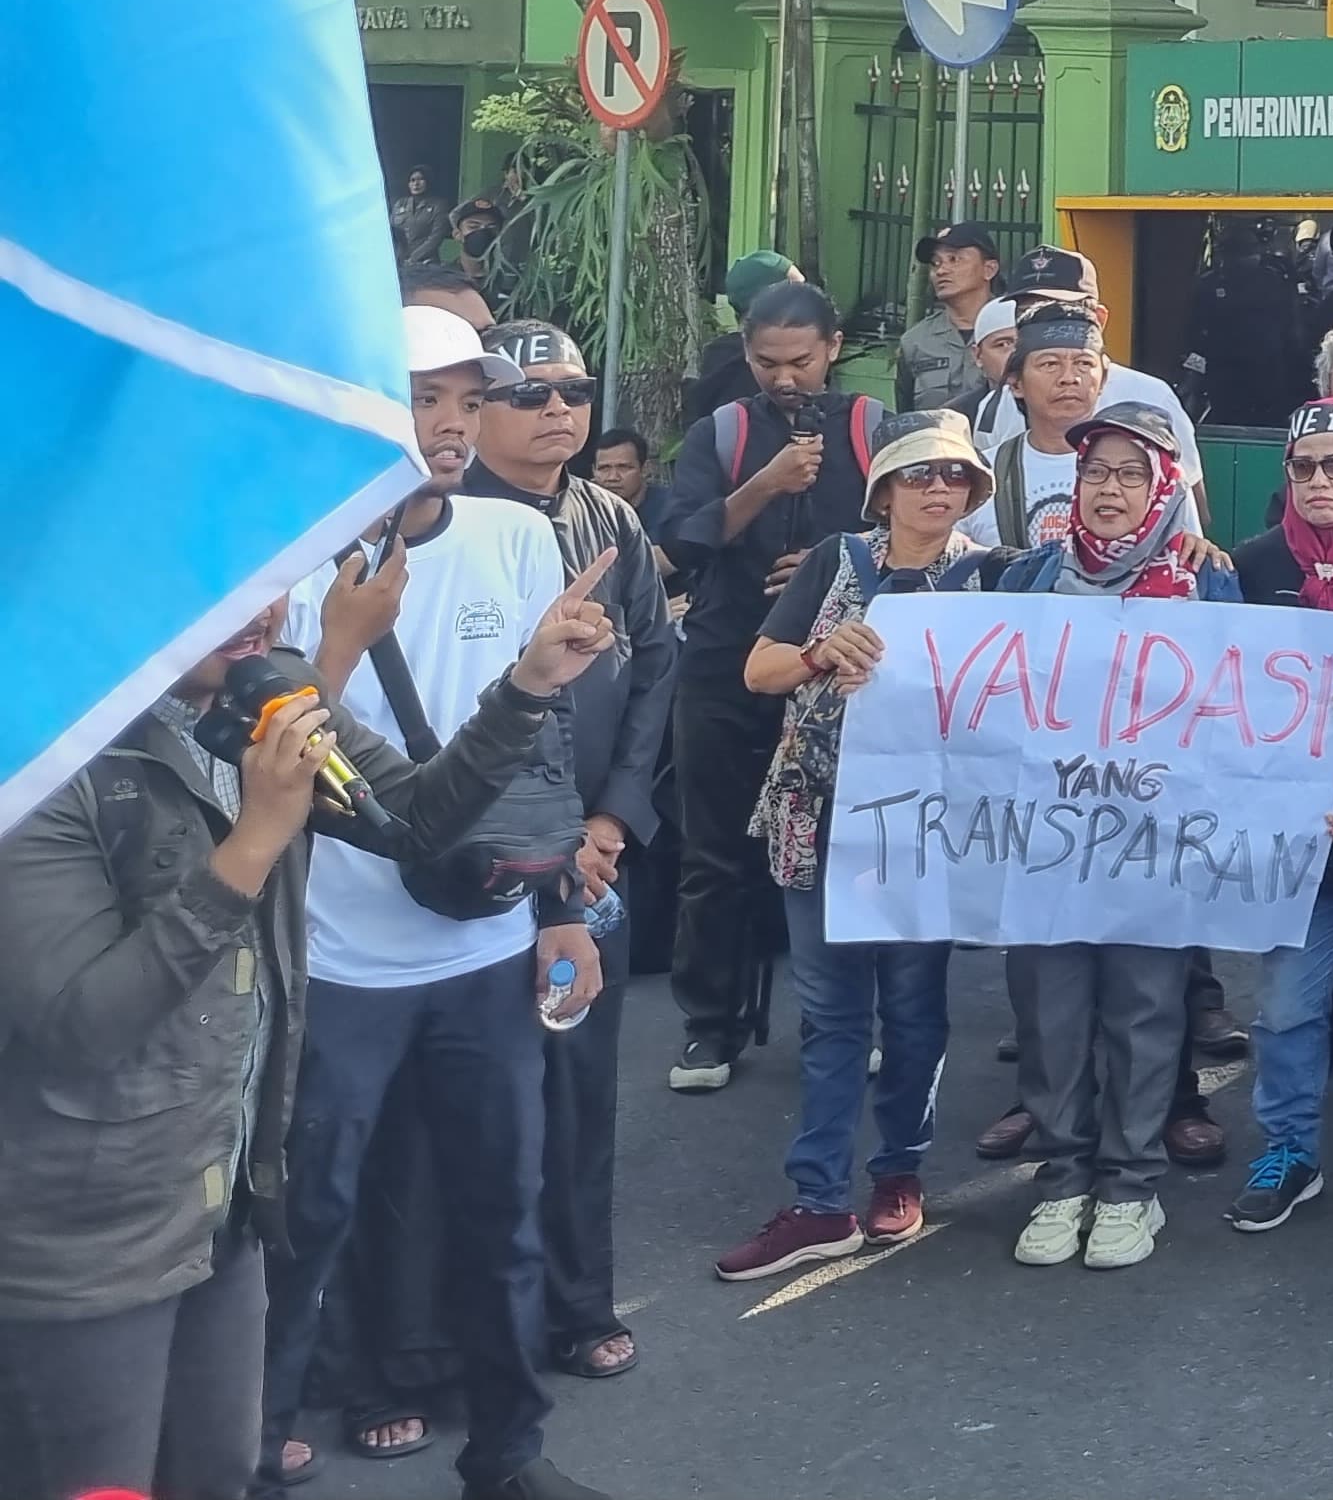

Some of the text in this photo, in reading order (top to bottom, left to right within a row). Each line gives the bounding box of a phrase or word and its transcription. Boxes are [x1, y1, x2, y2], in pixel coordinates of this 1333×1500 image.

[604, 11, 642, 97] P
[1053, 753, 1172, 801] YANG
[848, 788, 1318, 904] TRANSPARAN
